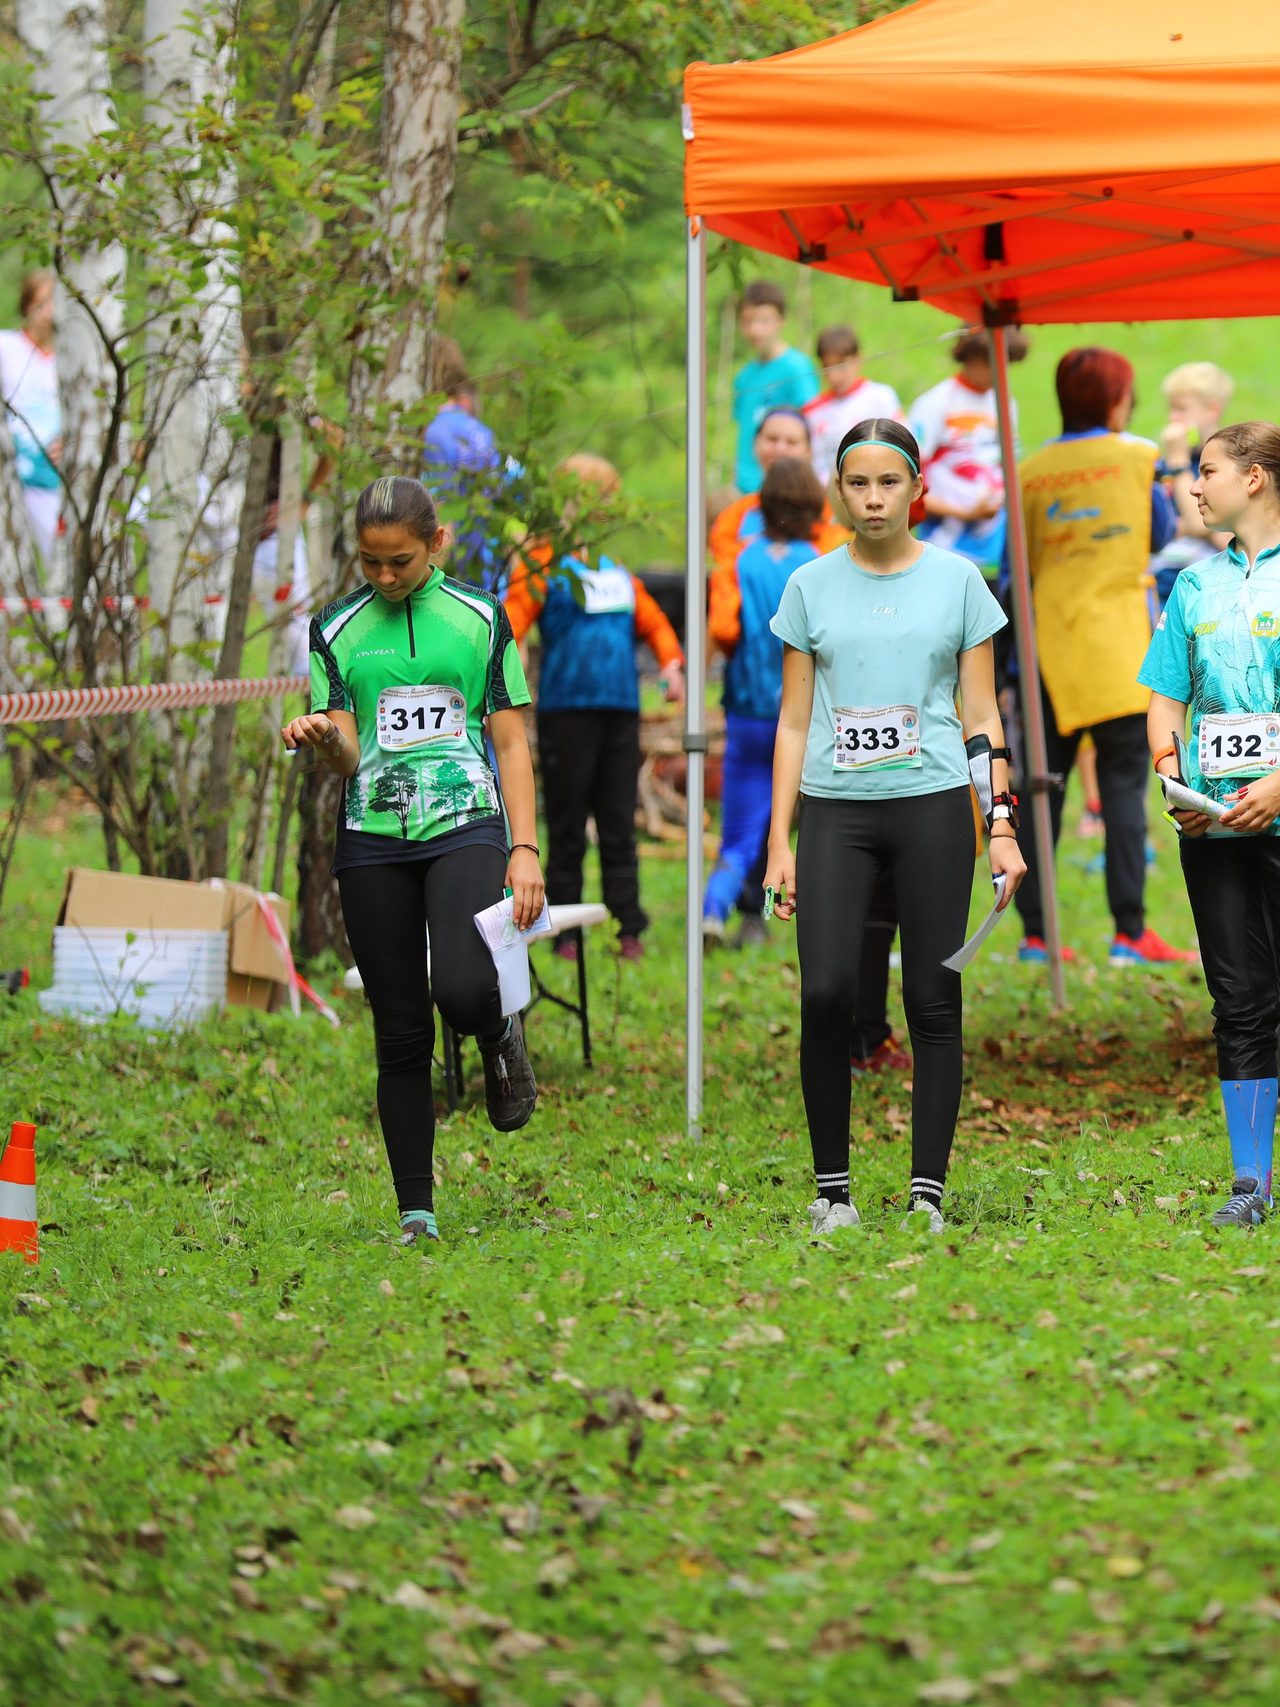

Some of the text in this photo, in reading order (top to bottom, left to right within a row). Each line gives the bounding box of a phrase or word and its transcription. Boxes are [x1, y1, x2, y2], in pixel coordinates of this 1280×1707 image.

[391, 707, 446, 731] 317
[845, 727, 900, 751] 333
[1211, 734, 1262, 758] 132
